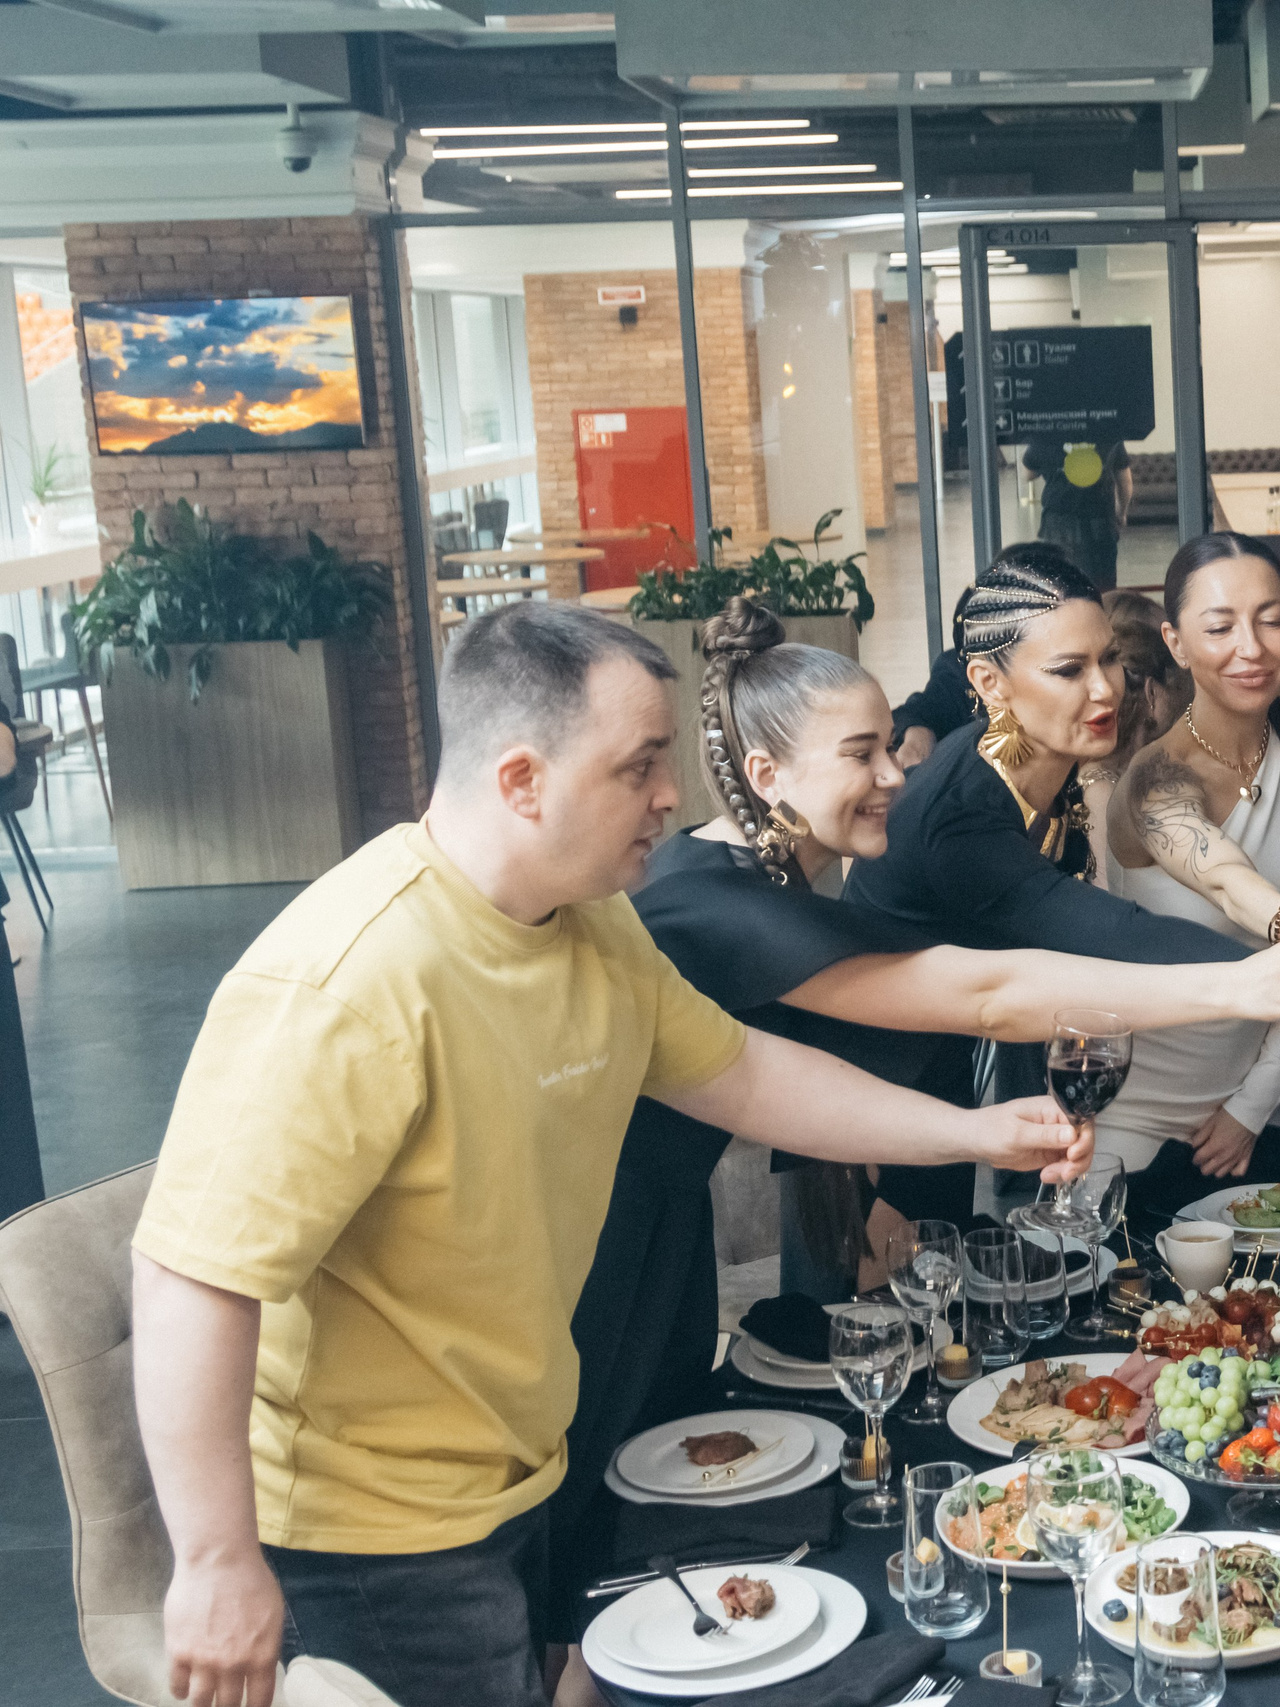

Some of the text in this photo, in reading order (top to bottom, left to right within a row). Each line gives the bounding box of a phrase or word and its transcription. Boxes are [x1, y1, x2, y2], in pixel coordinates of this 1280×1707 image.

[987, 228, 998, 243] C
[1044, 343, 1076, 353] Туалет
[1015, 378, 1033, 389] Бар
[1016, 409, 1118, 421] Медицинский пункт
